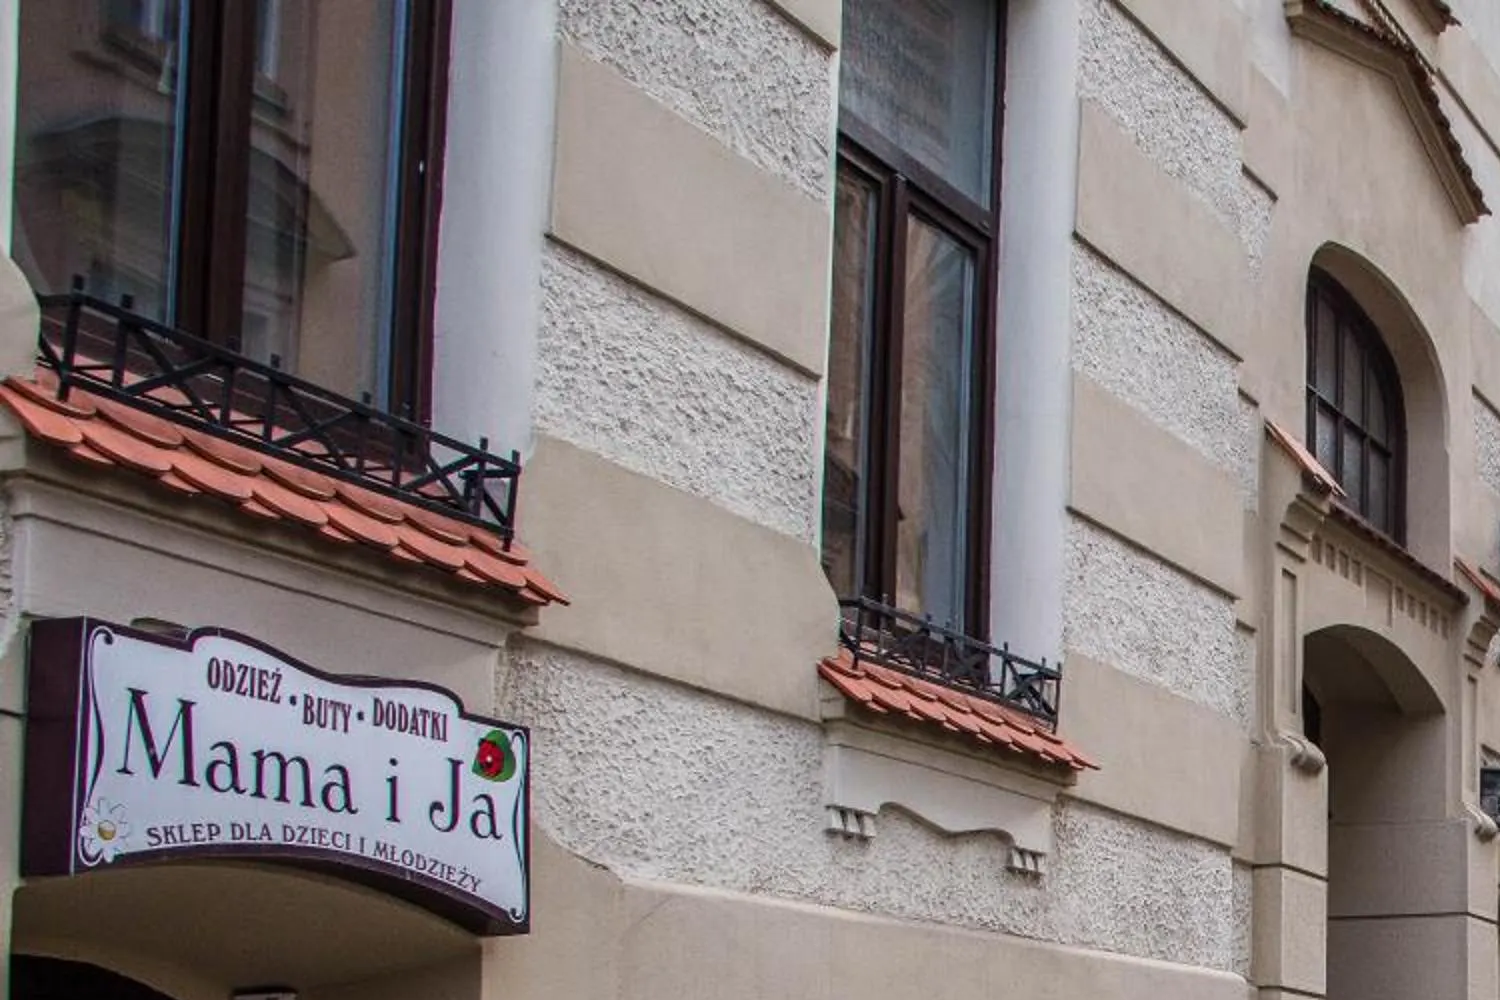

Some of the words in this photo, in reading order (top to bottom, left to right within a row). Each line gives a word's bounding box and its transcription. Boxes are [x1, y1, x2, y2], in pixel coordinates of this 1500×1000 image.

[207, 656, 284, 705] ODZIEŻ
[303, 693, 353, 735] BUTY
[372, 696, 450, 744] DODATKI
[116, 687, 359, 816] Mama
[385, 757, 401, 823] i
[428, 757, 503, 841] Ja
[146, 821, 221, 848] SKLEP
[231, 822, 274, 843] DLA
[282, 826, 353, 853] DZIECI
[358, 838, 367, 856] I
[372, 842, 483, 894] MŁODZIEŻY
